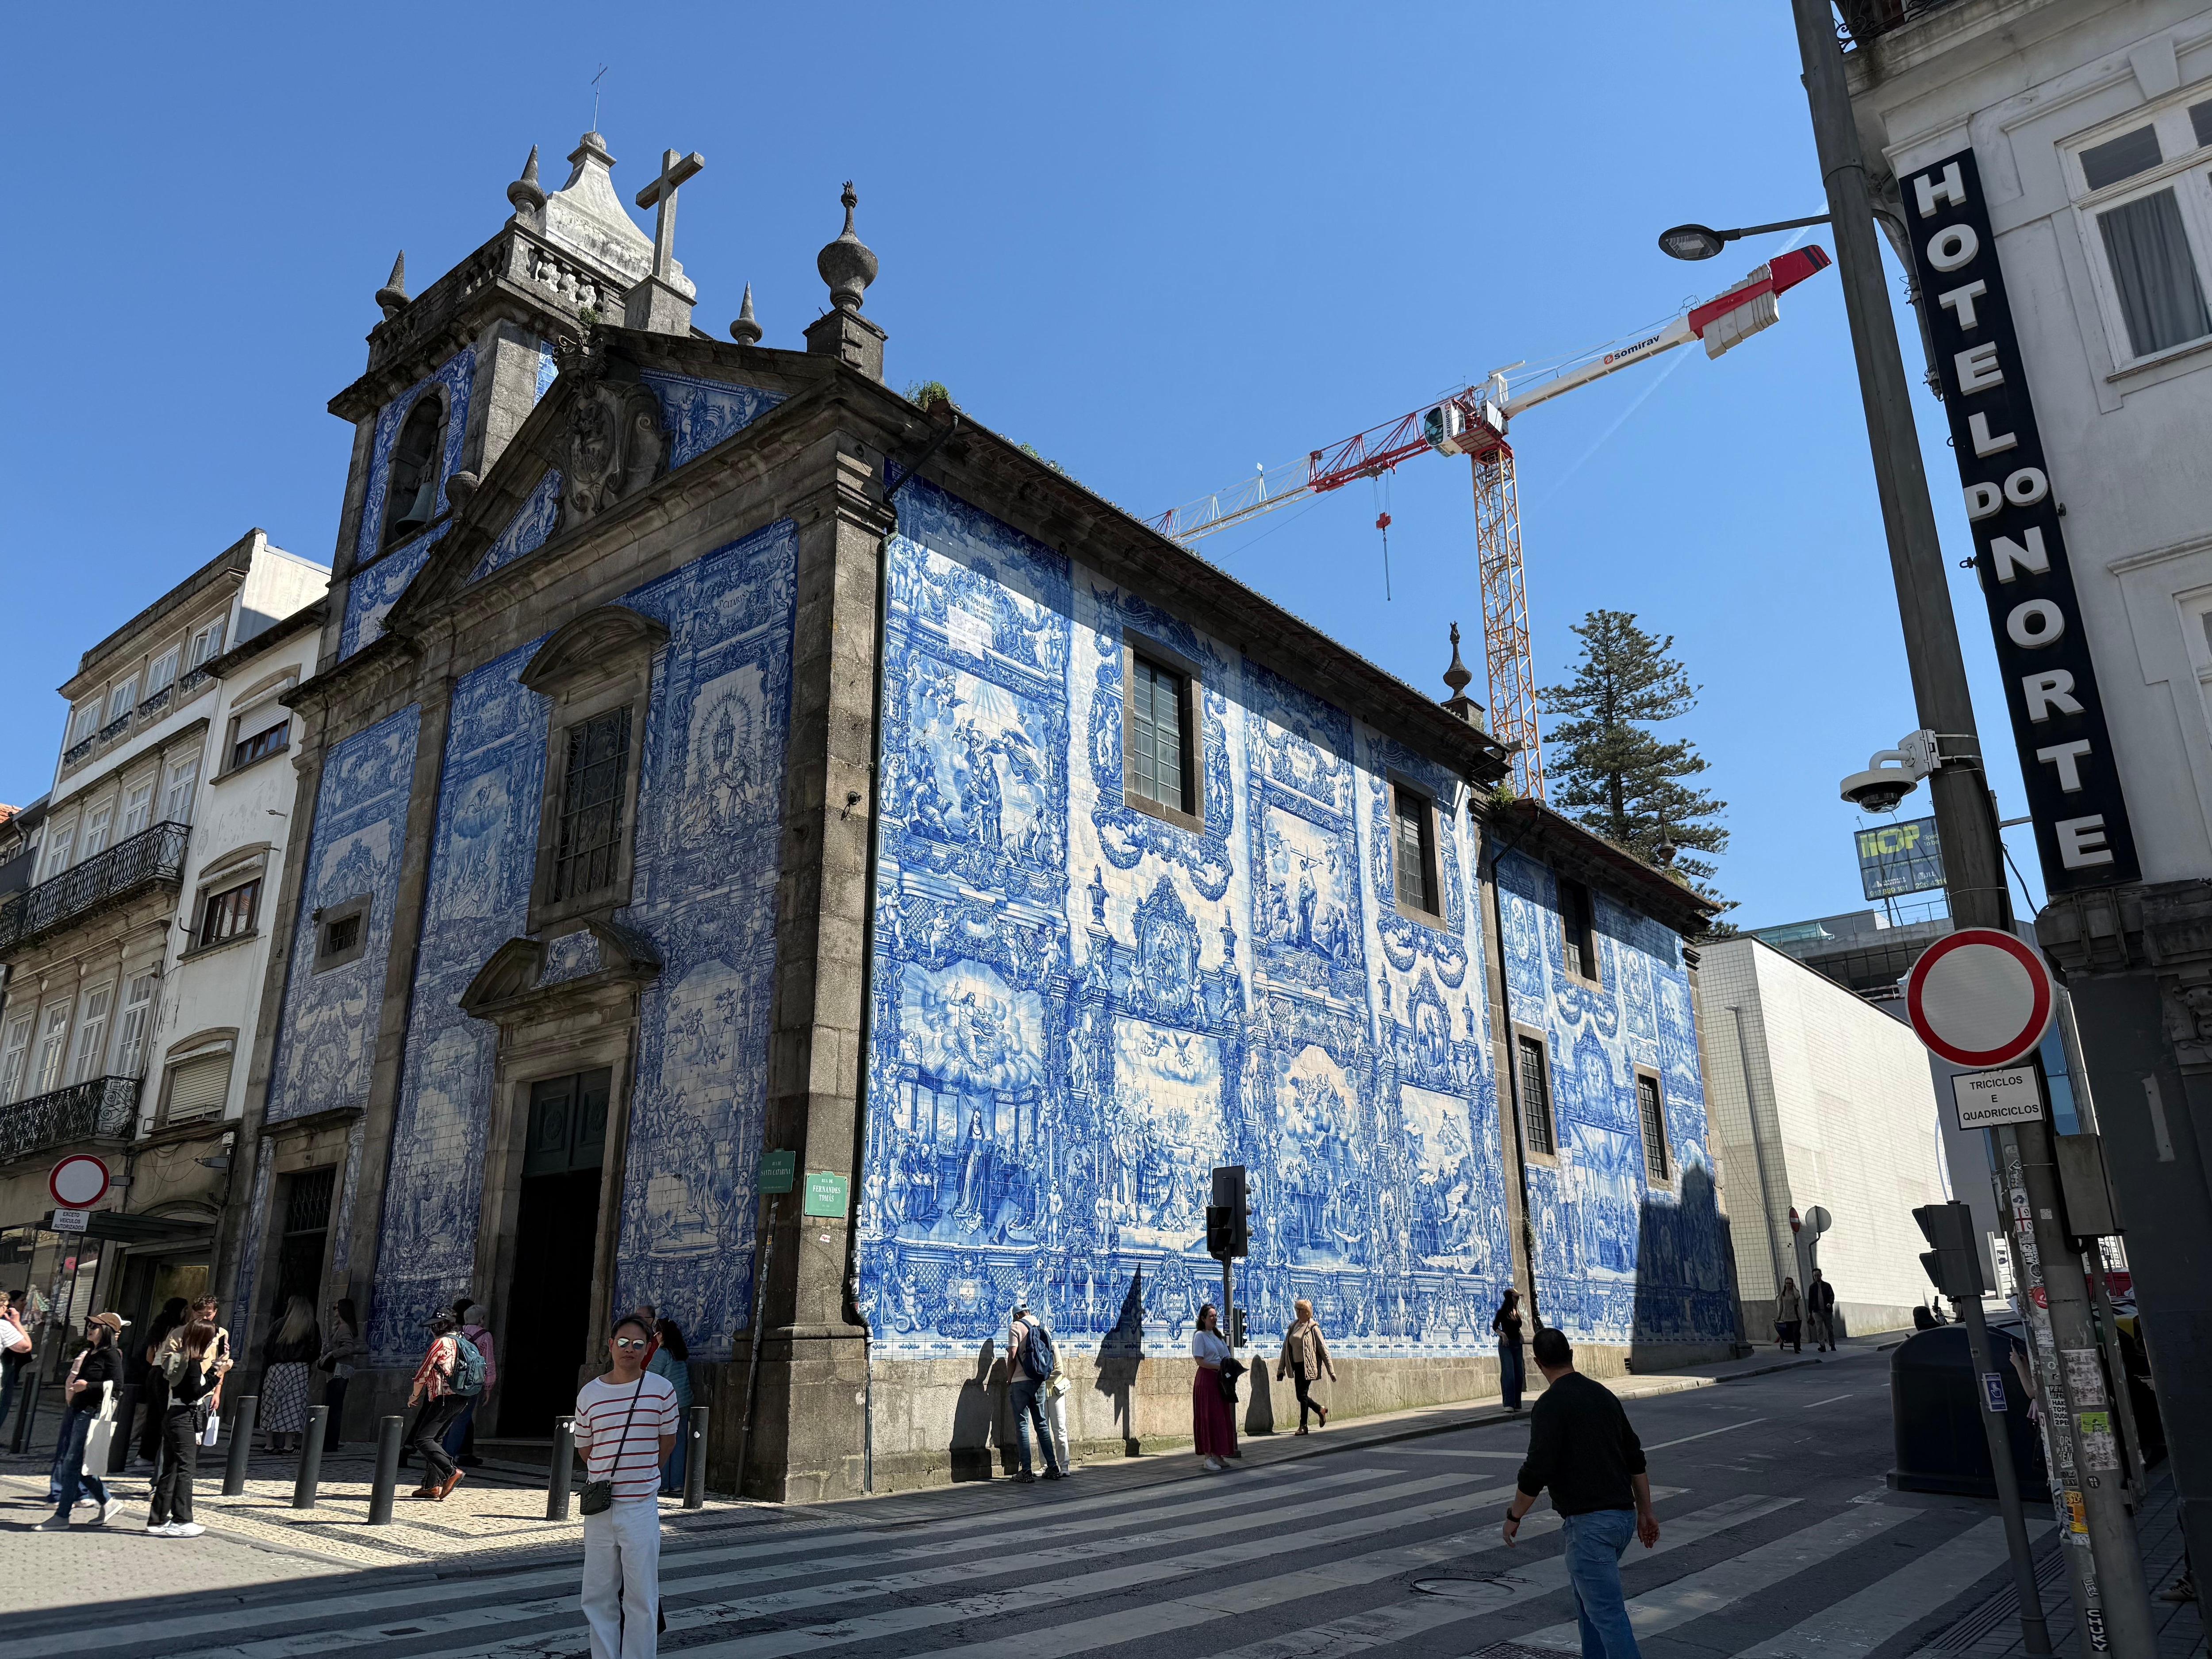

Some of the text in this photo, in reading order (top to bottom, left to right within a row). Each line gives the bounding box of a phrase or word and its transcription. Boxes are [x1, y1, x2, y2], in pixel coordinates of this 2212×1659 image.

[1913, 162, 2018, 457] HOTEL
[1614, 335, 1659, 360] somirav
[1966, 467, 2048, 520] DO
[1990, 526, 2114, 870] NORTE
[1969, 1076, 2023, 1090] TRICICLOS
[1963, 1104, 2039, 1121] QUADRICICLOS
[813, 1185, 841, 1194] FERNANDES
[2023, 1244, 2035, 1263] CREW
